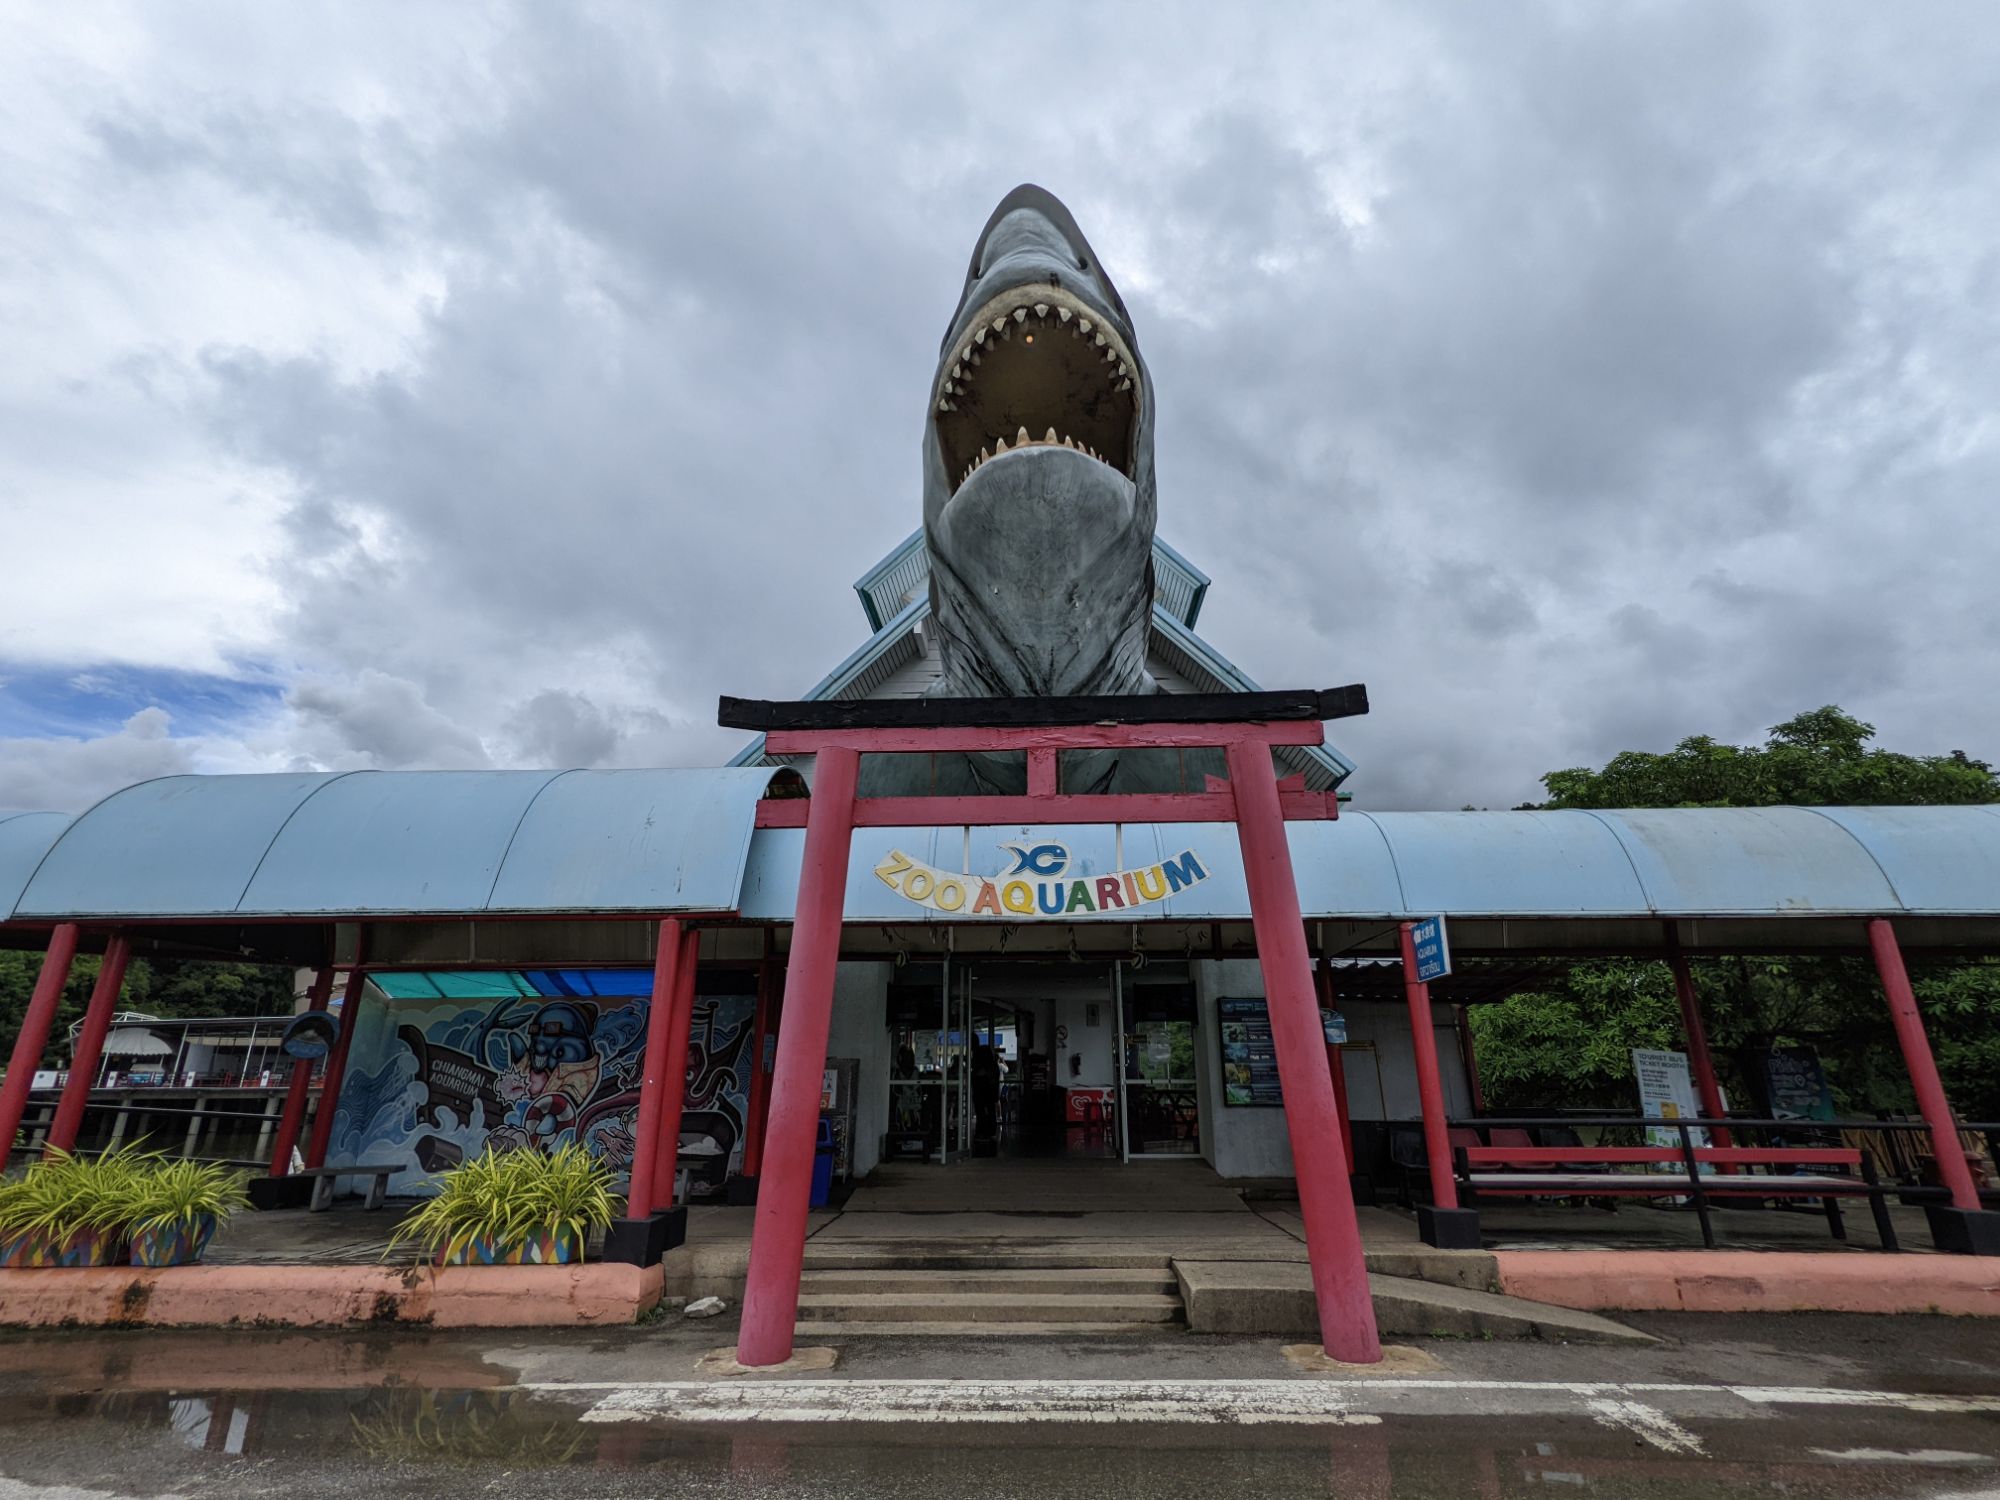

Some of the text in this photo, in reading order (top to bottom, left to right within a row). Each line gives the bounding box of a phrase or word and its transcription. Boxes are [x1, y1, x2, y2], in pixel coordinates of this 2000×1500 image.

[874, 851, 1206, 915] ZOO AQUARIUM
[432, 1059, 486, 1089] CHIANGMAI
